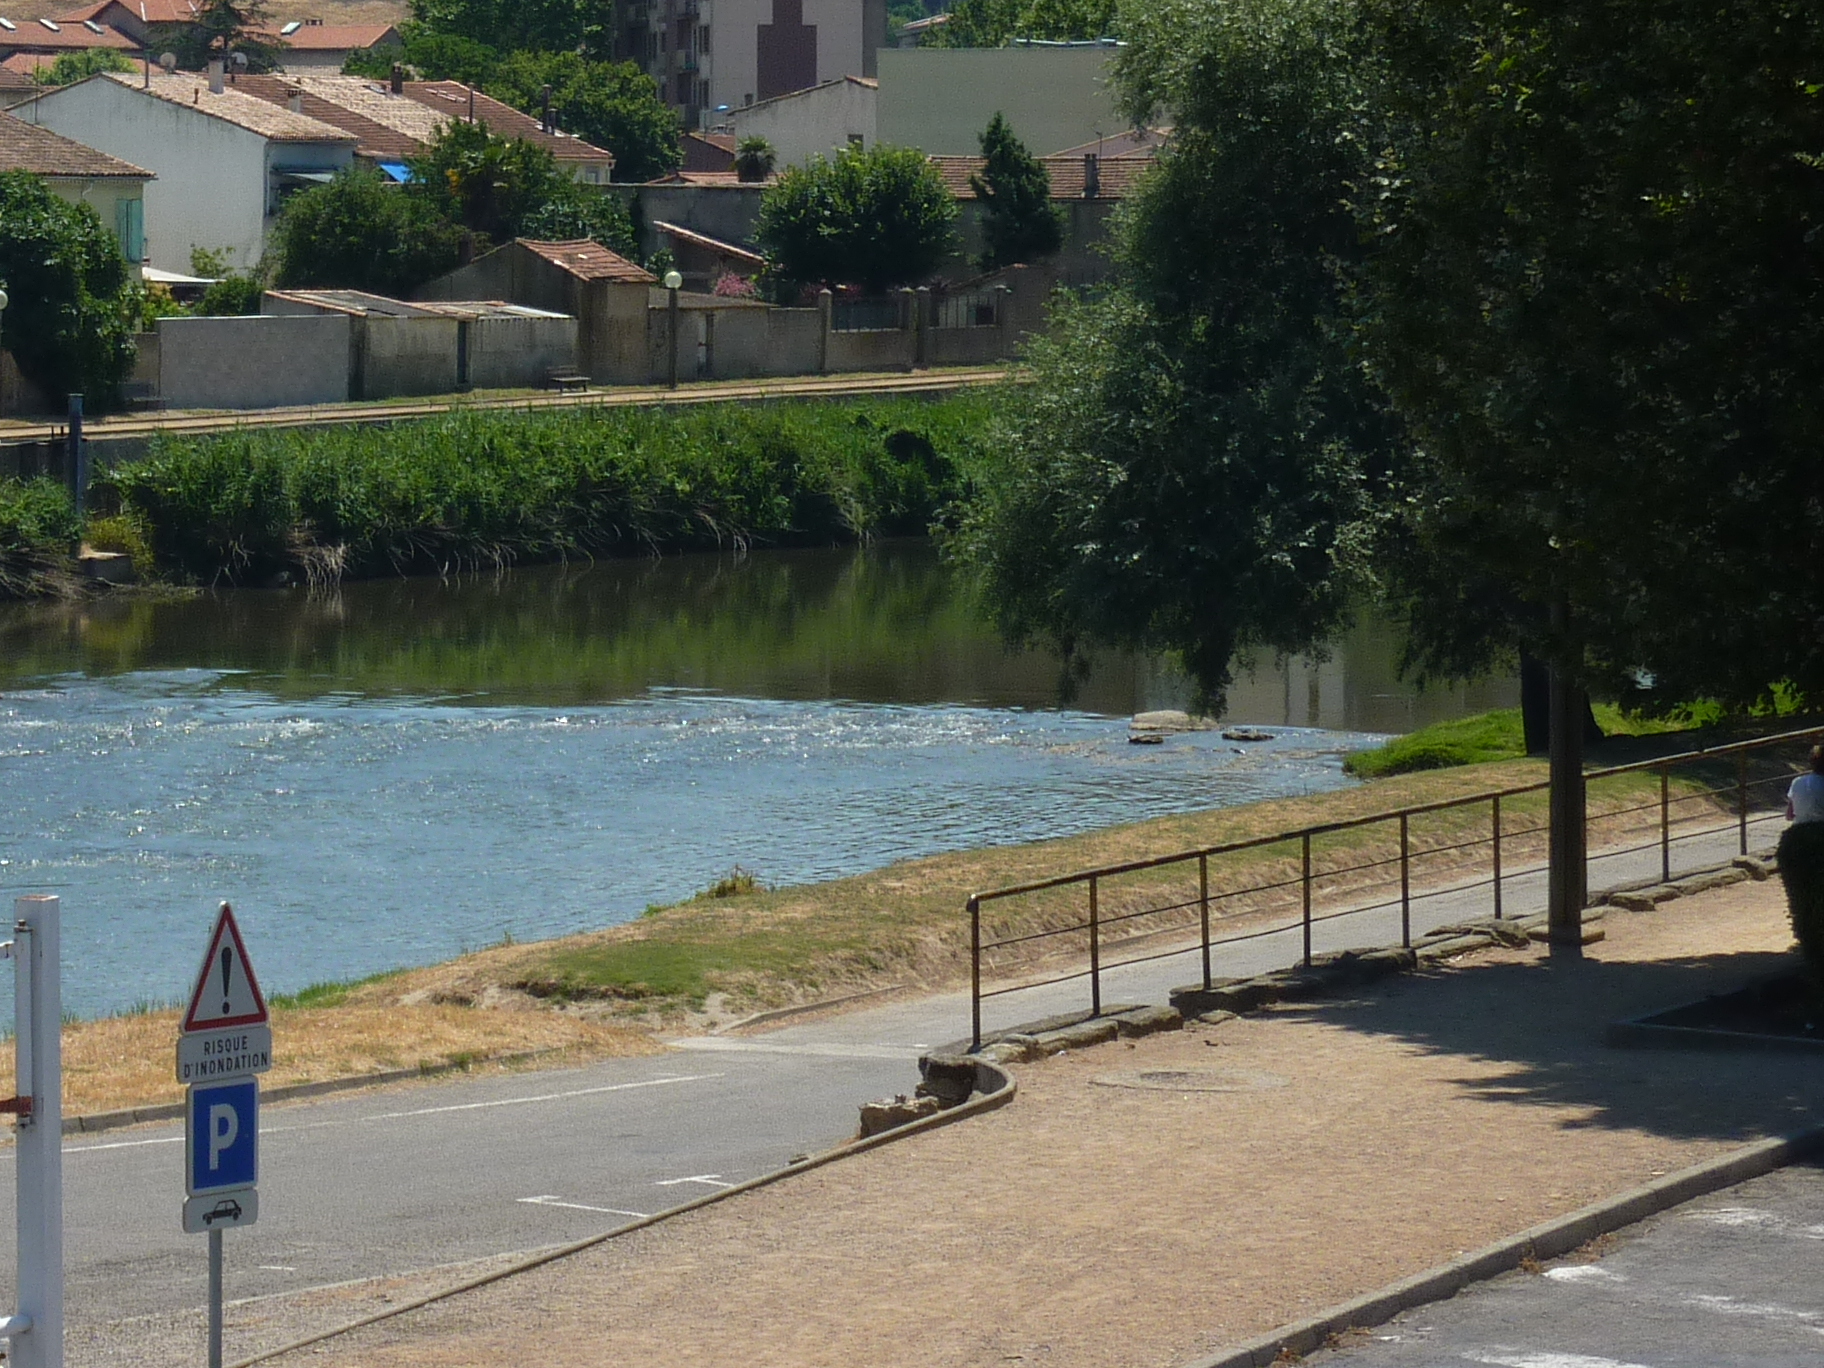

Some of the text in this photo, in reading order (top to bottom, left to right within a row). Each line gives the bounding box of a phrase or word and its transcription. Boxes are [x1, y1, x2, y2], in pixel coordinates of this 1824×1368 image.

[204, 1036, 248, 1055] RISQUE
[184, 1052, 268, 1078] D'INONDATION
[209, 1103, 238, 1170] P
